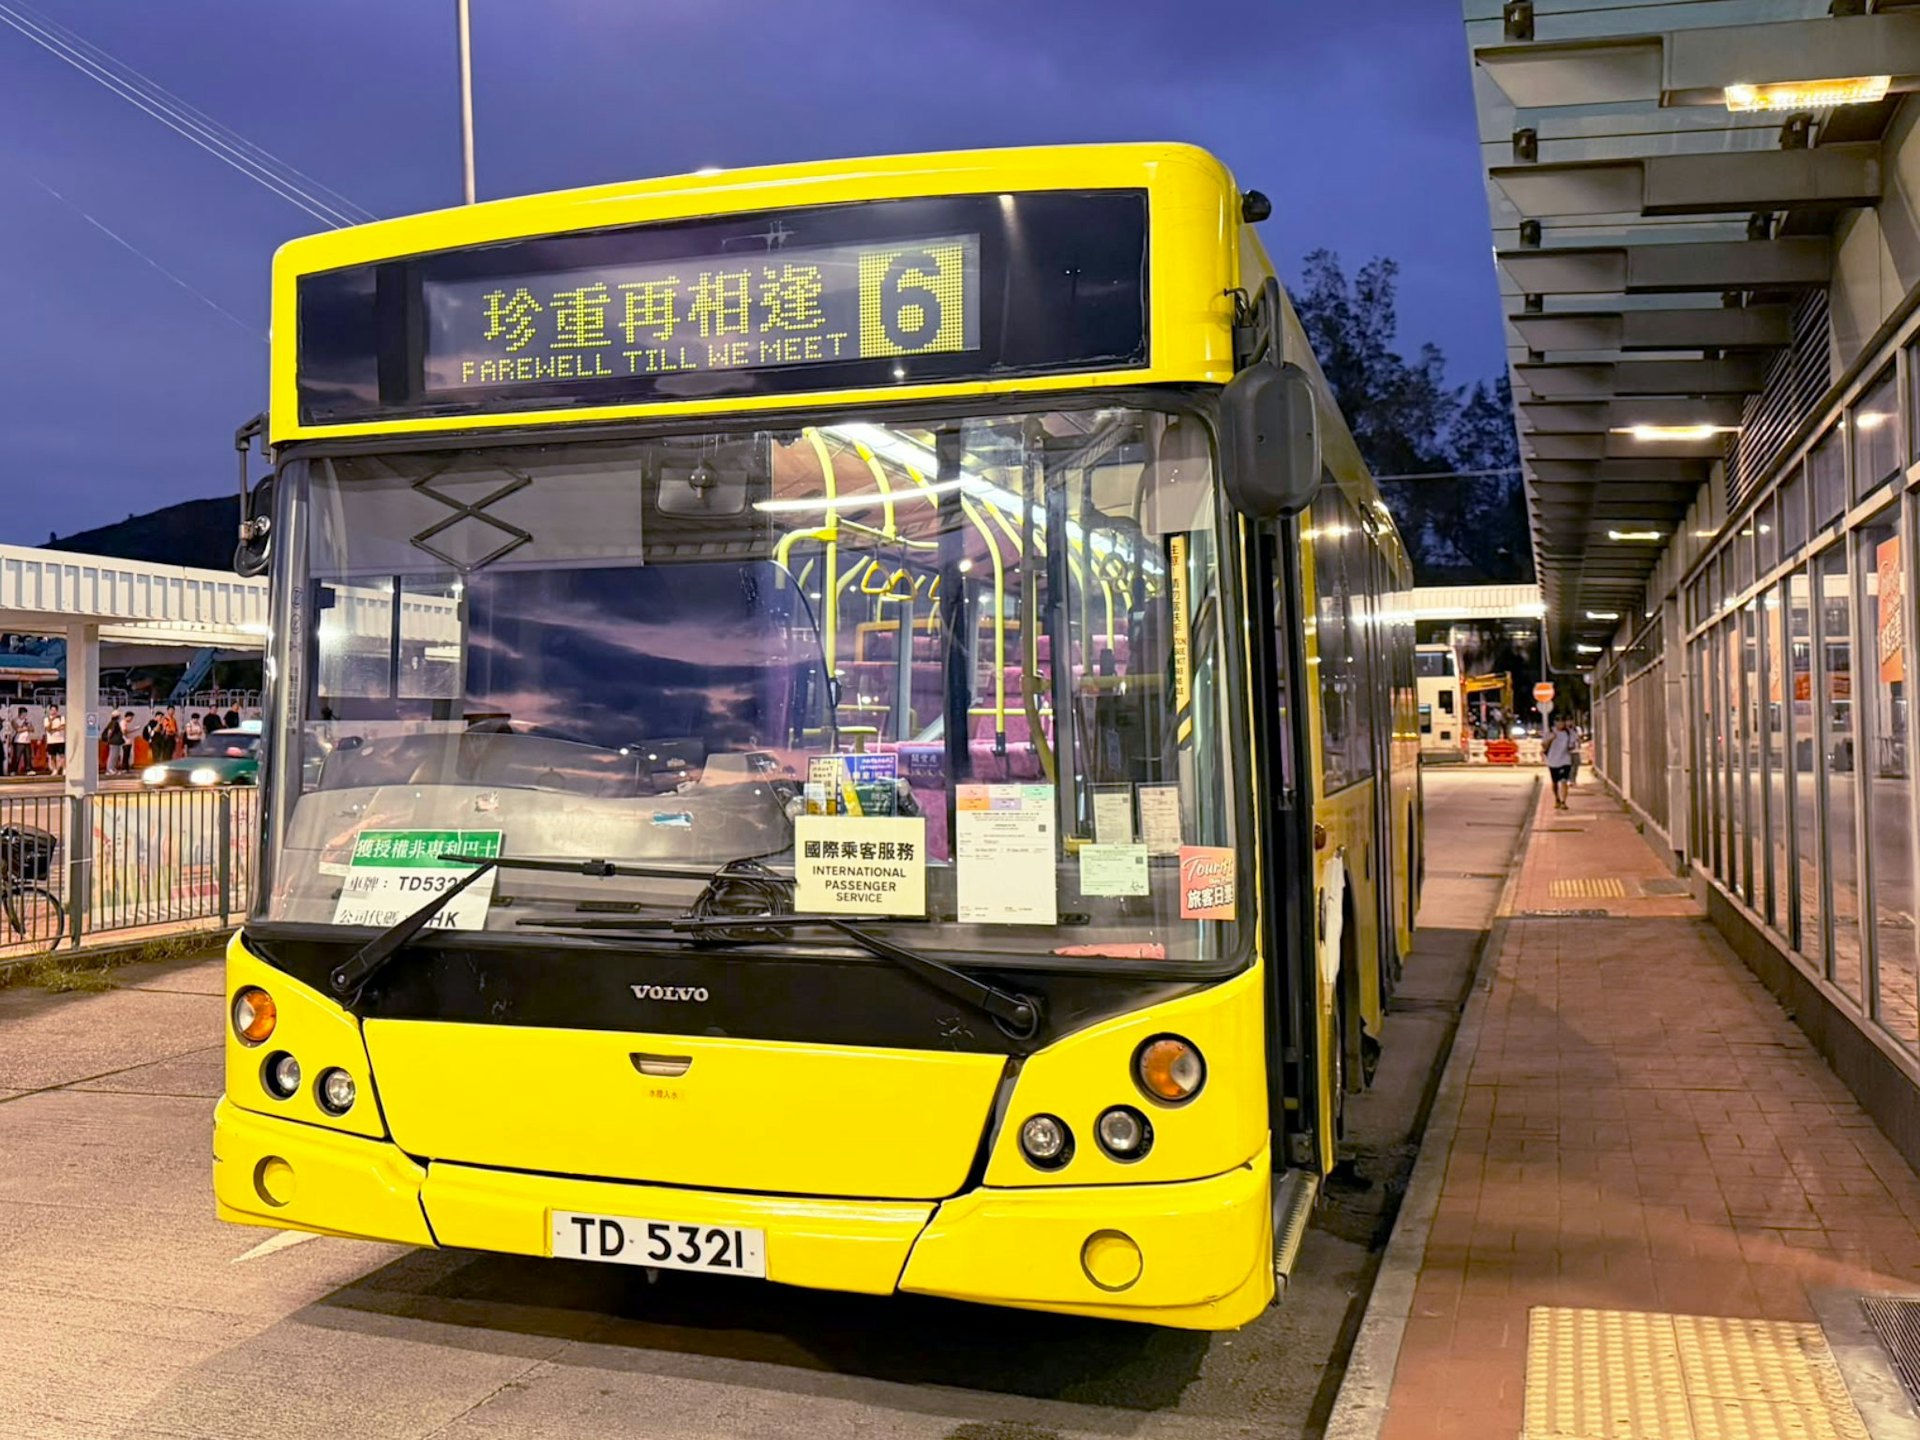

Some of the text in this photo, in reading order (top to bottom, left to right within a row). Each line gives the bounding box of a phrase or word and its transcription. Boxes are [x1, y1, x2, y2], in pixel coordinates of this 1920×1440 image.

[483, 263, 827, 353] 珍重再相逢
[879, 249, 942, 352] 6
[461, 331, 849, 385] FAREWELL TILL WE MEET
[355, 838, 499, 860] 獲授權非專利巴士
[804, 840, 915, 862] 國際乘客服務
[812, 865, 908, 879] INTERNATIONAL
[399, 876, 466, 893] TD532
[825, 879, 897, 893] PASSENGER
[836, 892, 883, 904] SERVICE
[630, 984, 710, 1003] VOLVO
[570, 1216, 744, 1270] TD 5321
